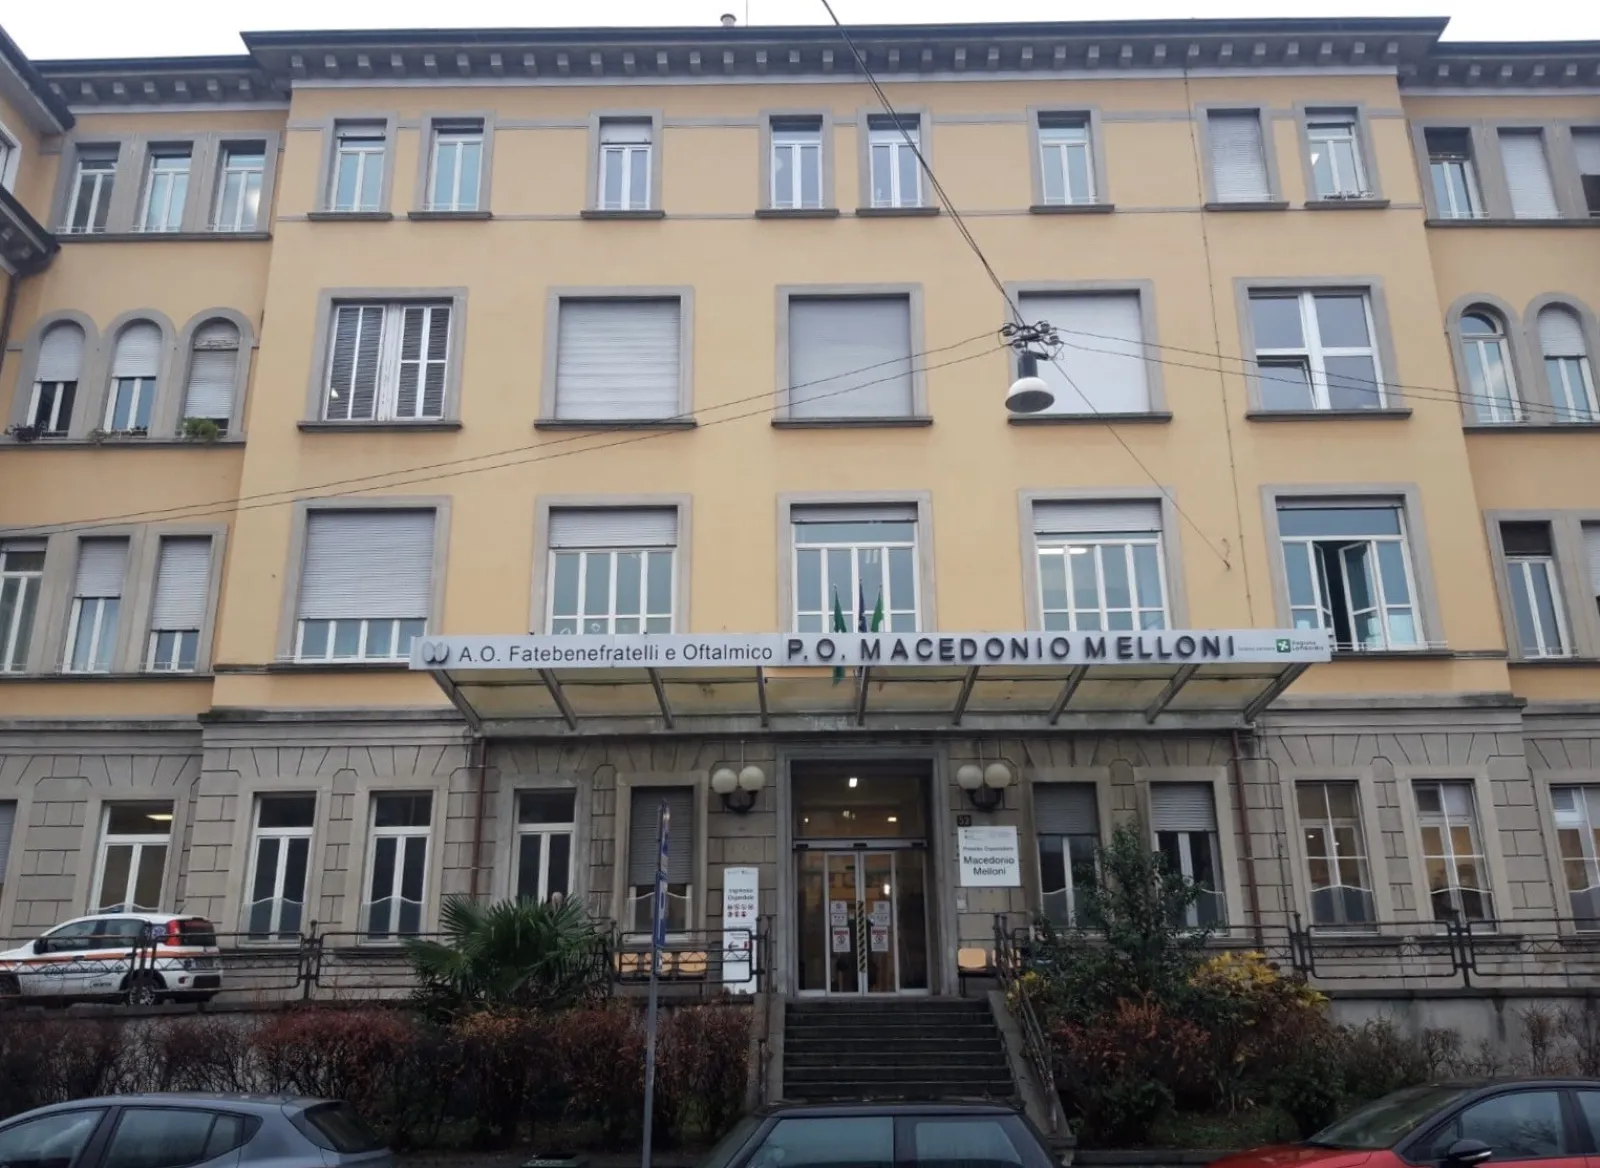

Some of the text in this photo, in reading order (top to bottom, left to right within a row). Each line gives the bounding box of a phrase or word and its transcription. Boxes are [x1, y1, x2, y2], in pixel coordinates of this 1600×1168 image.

[458, 643, 773, 662] A.O. Fatebenefratelli e Oftalmico
[787, 635, 1234, 662] P.O. MACEDONIO MELLONI
[963, 856, 1015, 865] Macedonio
[973, 867, 1006, 876] Melloni
